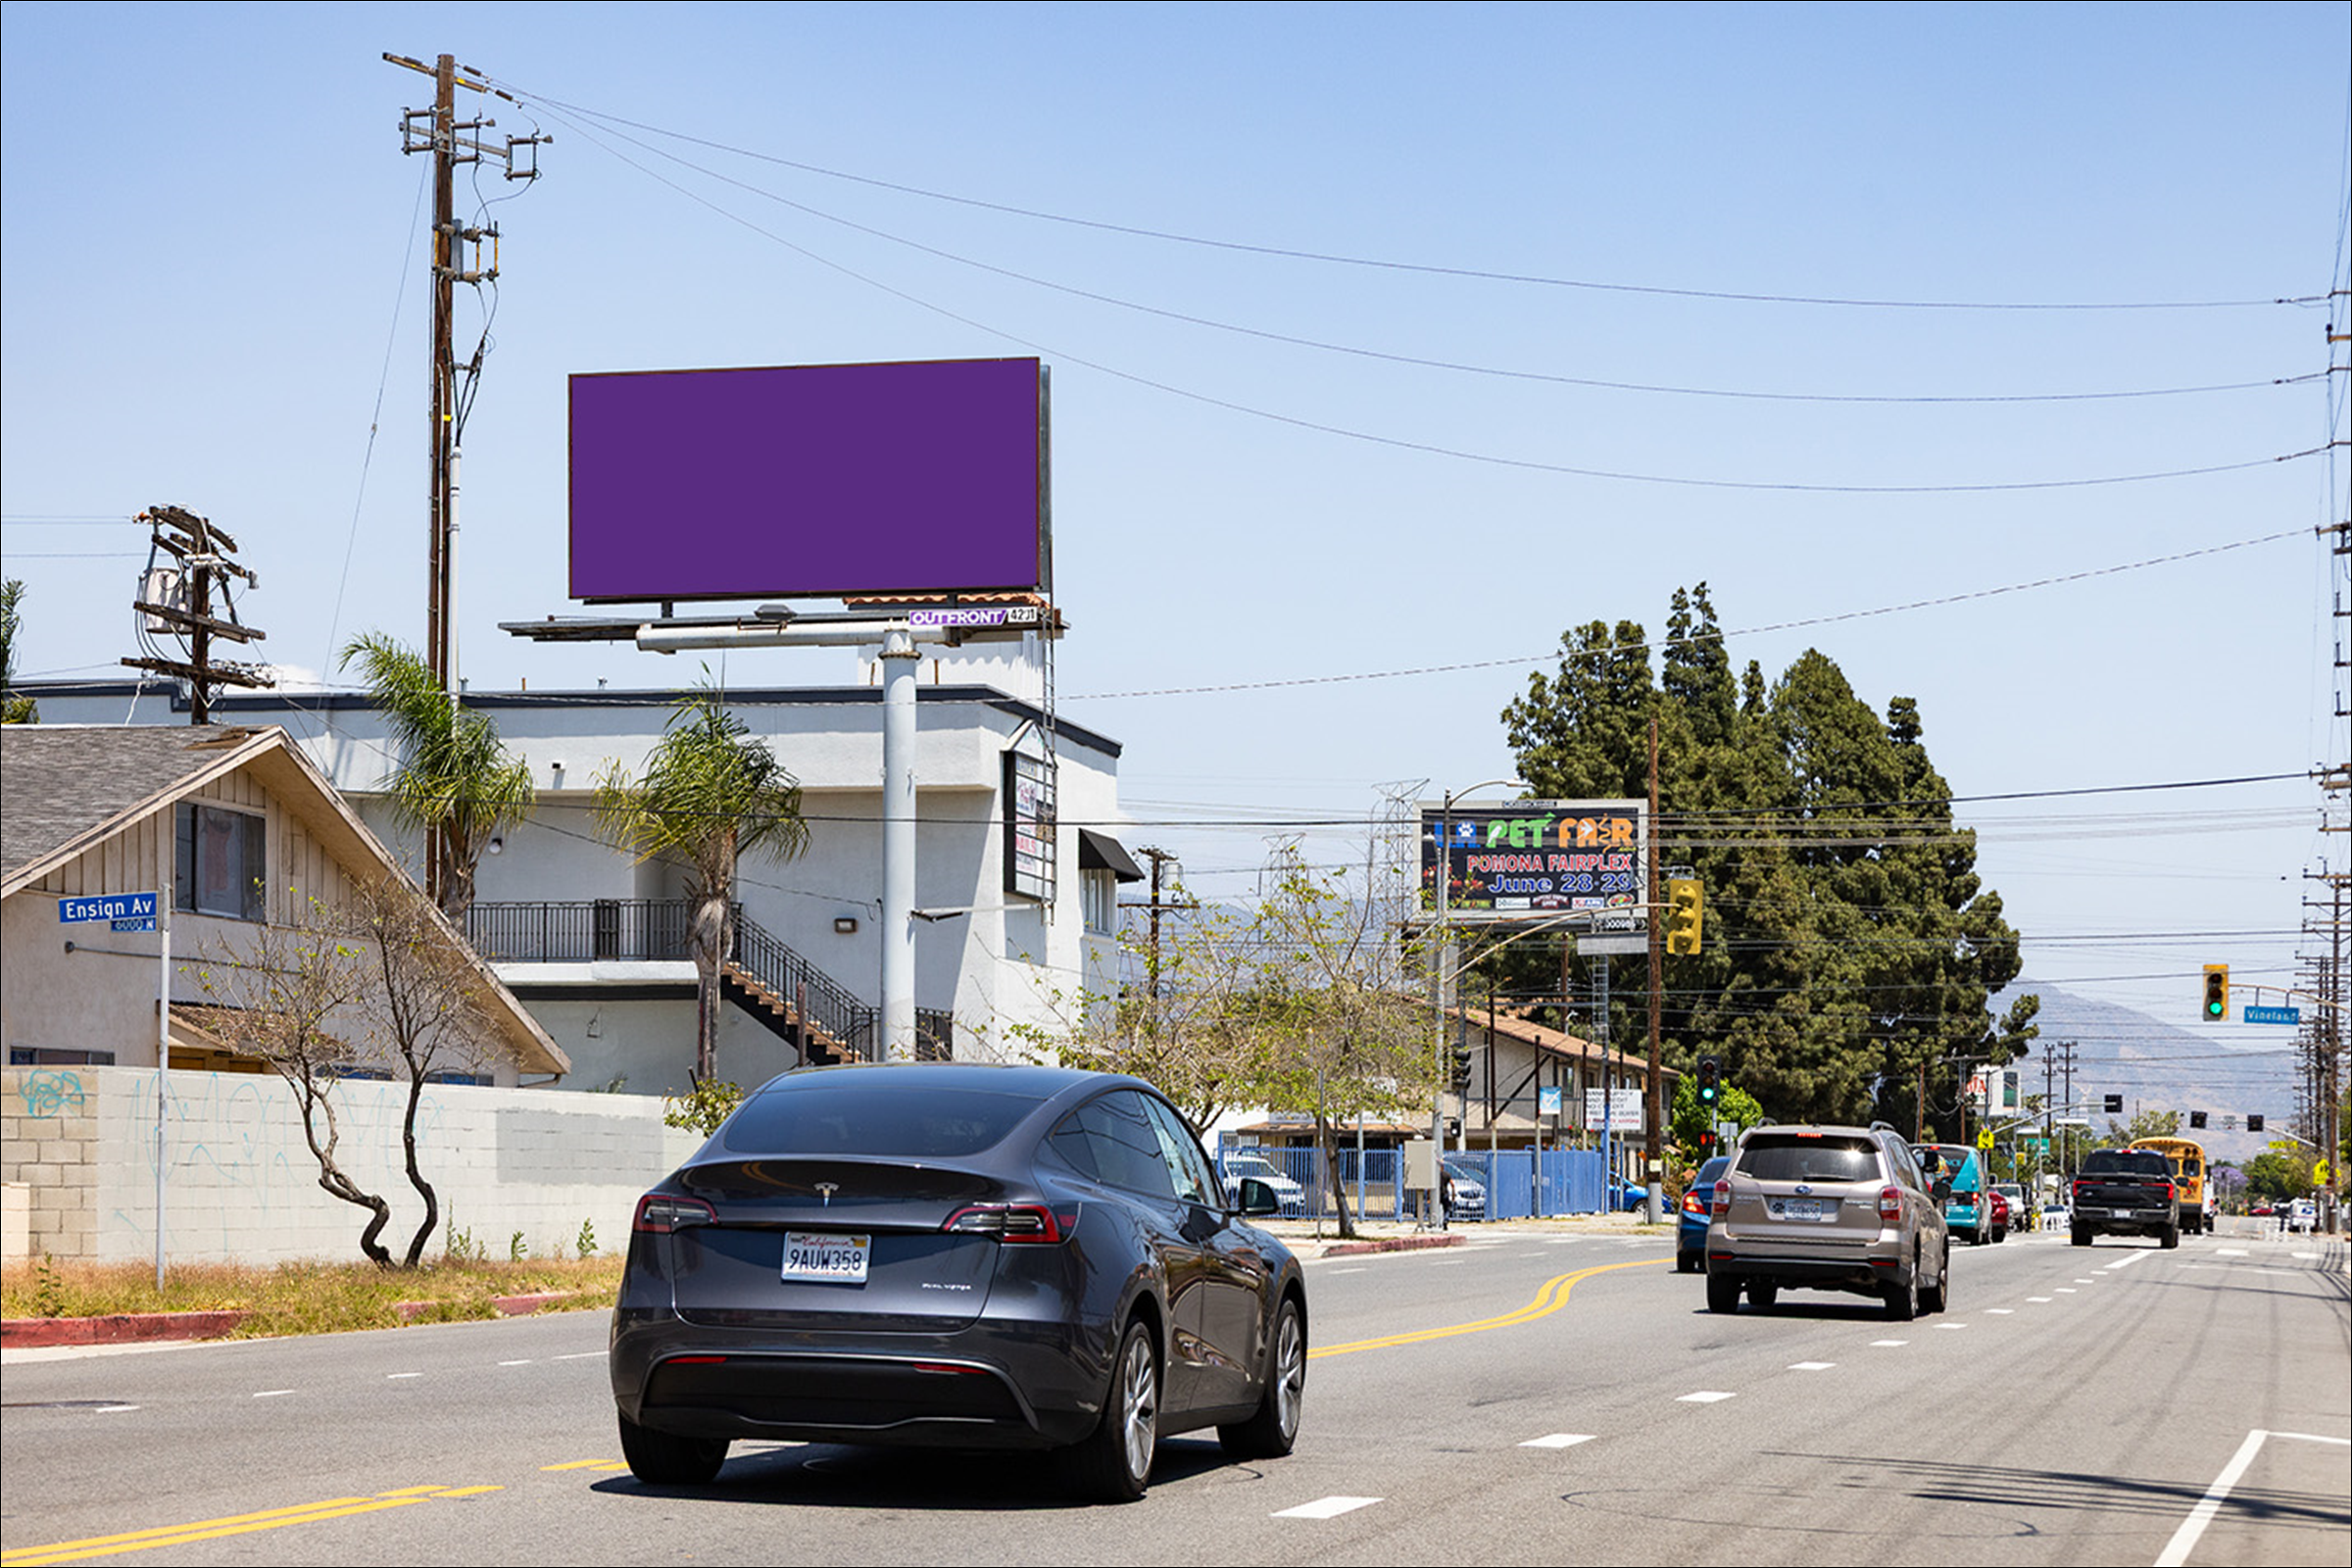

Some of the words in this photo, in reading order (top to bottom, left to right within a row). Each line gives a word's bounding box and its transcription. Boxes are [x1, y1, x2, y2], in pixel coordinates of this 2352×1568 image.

[911, 611, 1002, 624] OUTFRONT
[1486, 811, 1556, 849] PET
[1467, 855, 1544, 872] POMONA
[1548, 854, 1633, 872] FAIRPLEX
[1488, 874, 1553, 893] June
[66, 900, 125, 919] Ensign
[131, 898, 152, 914] Av
[2247, 1009, 2297, 1021] Vineland
[789, 1249, 862, 1272] 9AUW358
